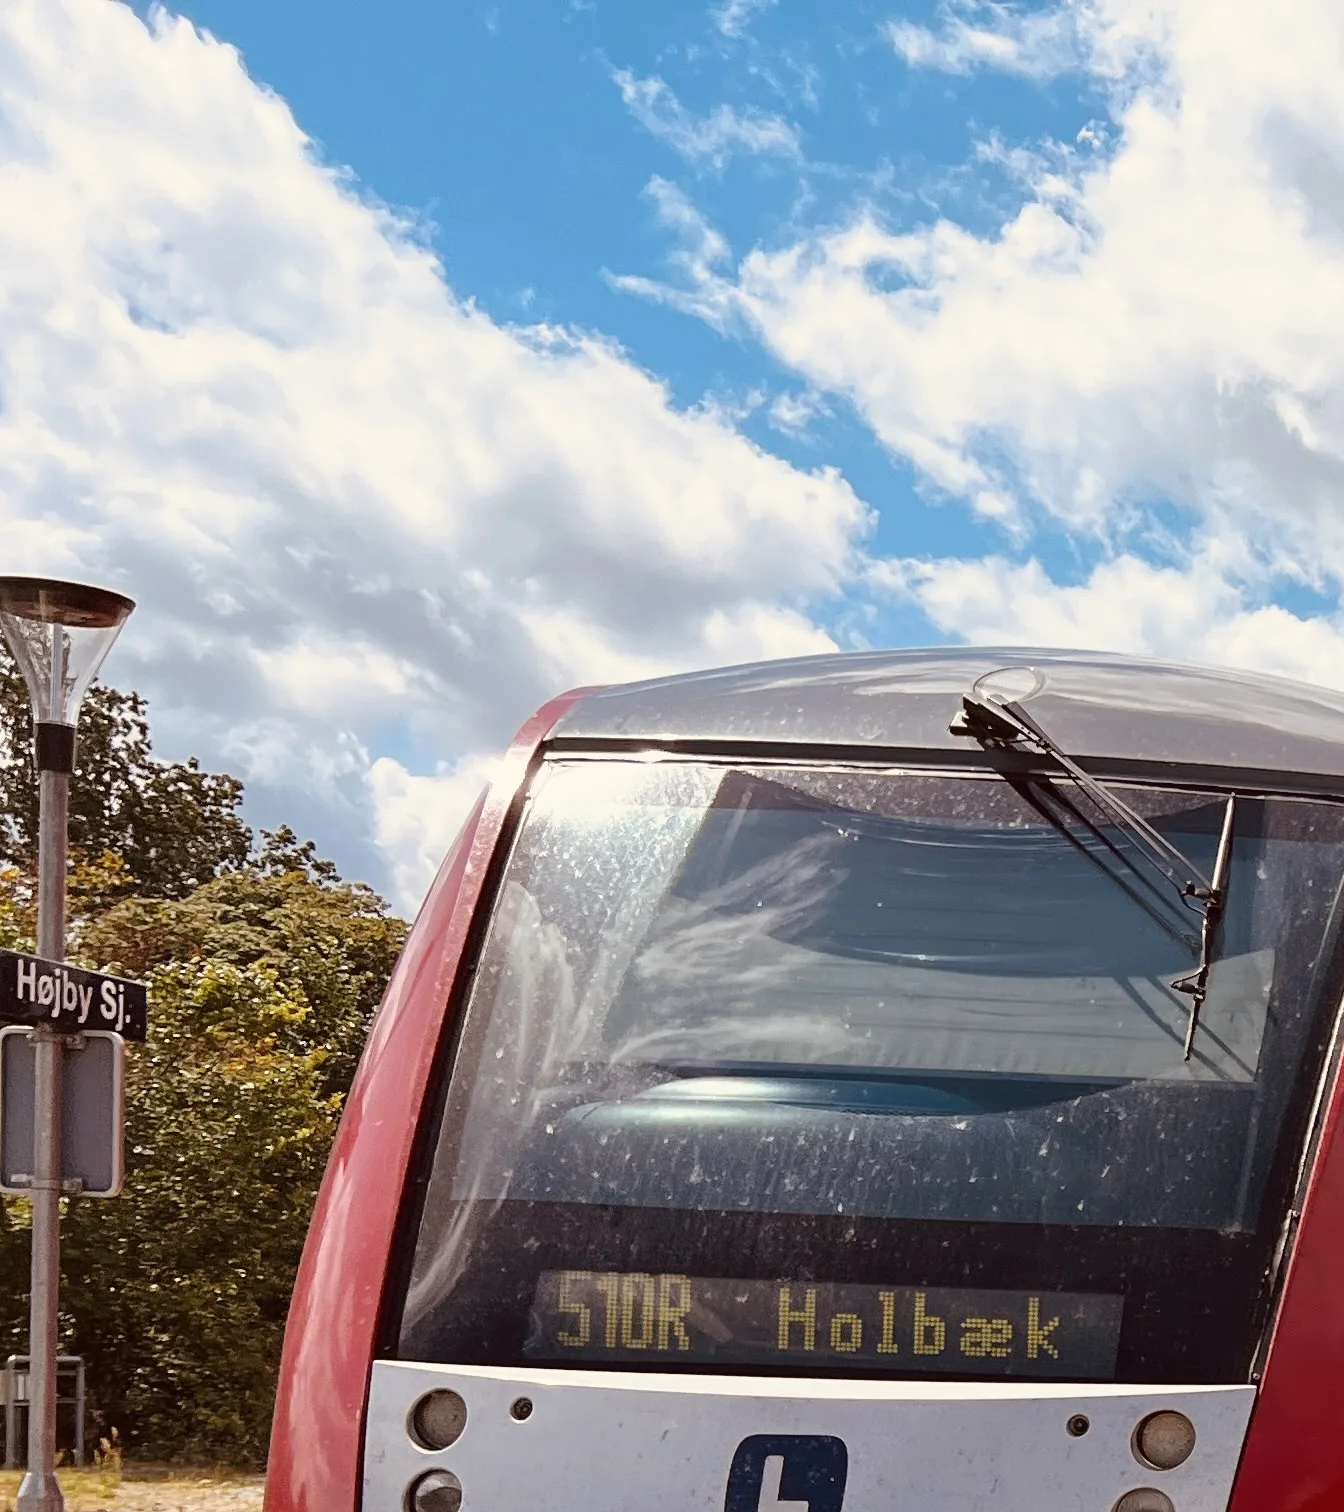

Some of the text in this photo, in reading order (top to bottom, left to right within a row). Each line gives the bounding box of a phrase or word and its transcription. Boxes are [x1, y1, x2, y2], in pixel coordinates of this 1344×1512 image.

[16, 958, 131, 1031] Højby Sj.
[556, 1269, 1061, 1360] 510R Holbæk
